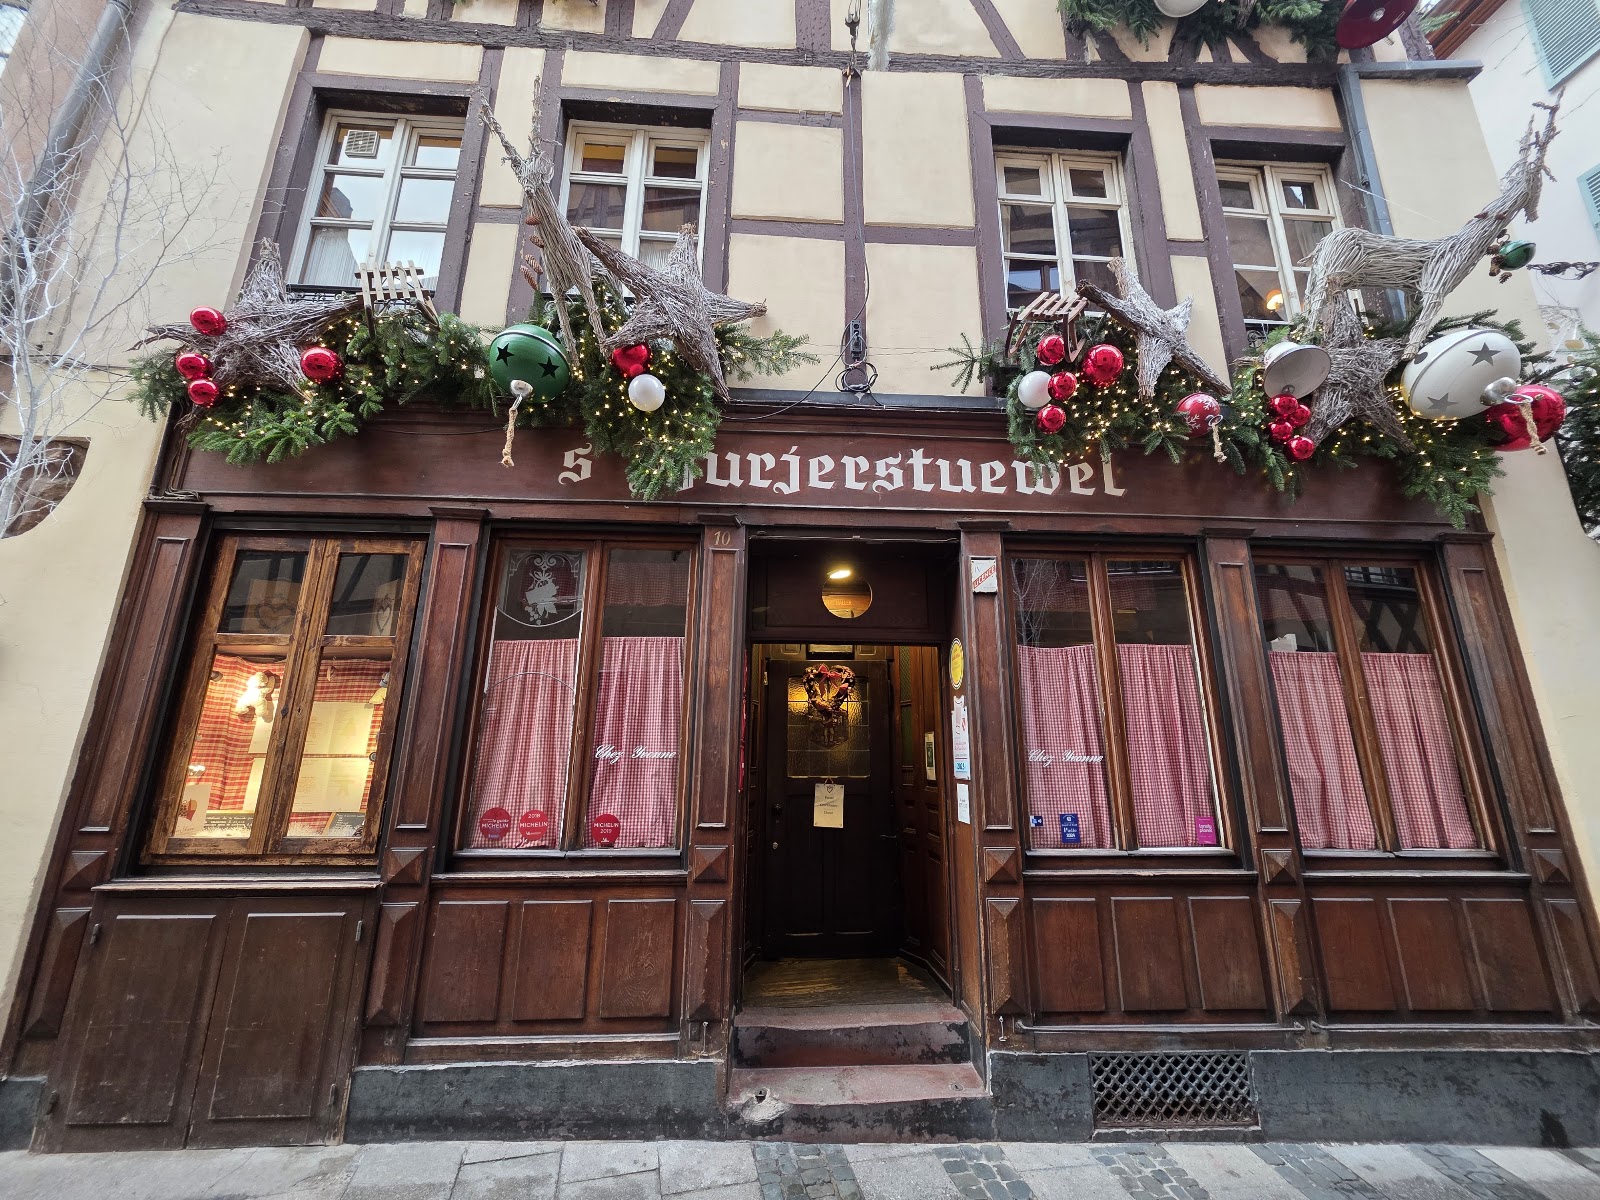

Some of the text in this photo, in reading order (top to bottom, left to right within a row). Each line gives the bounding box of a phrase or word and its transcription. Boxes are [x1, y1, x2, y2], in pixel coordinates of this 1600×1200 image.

[714, 531, 731, 546] 10
[595, 745, 677, 764] Chez Yvonne
[1028, 749, 1104, 768] Chez Yvonne
